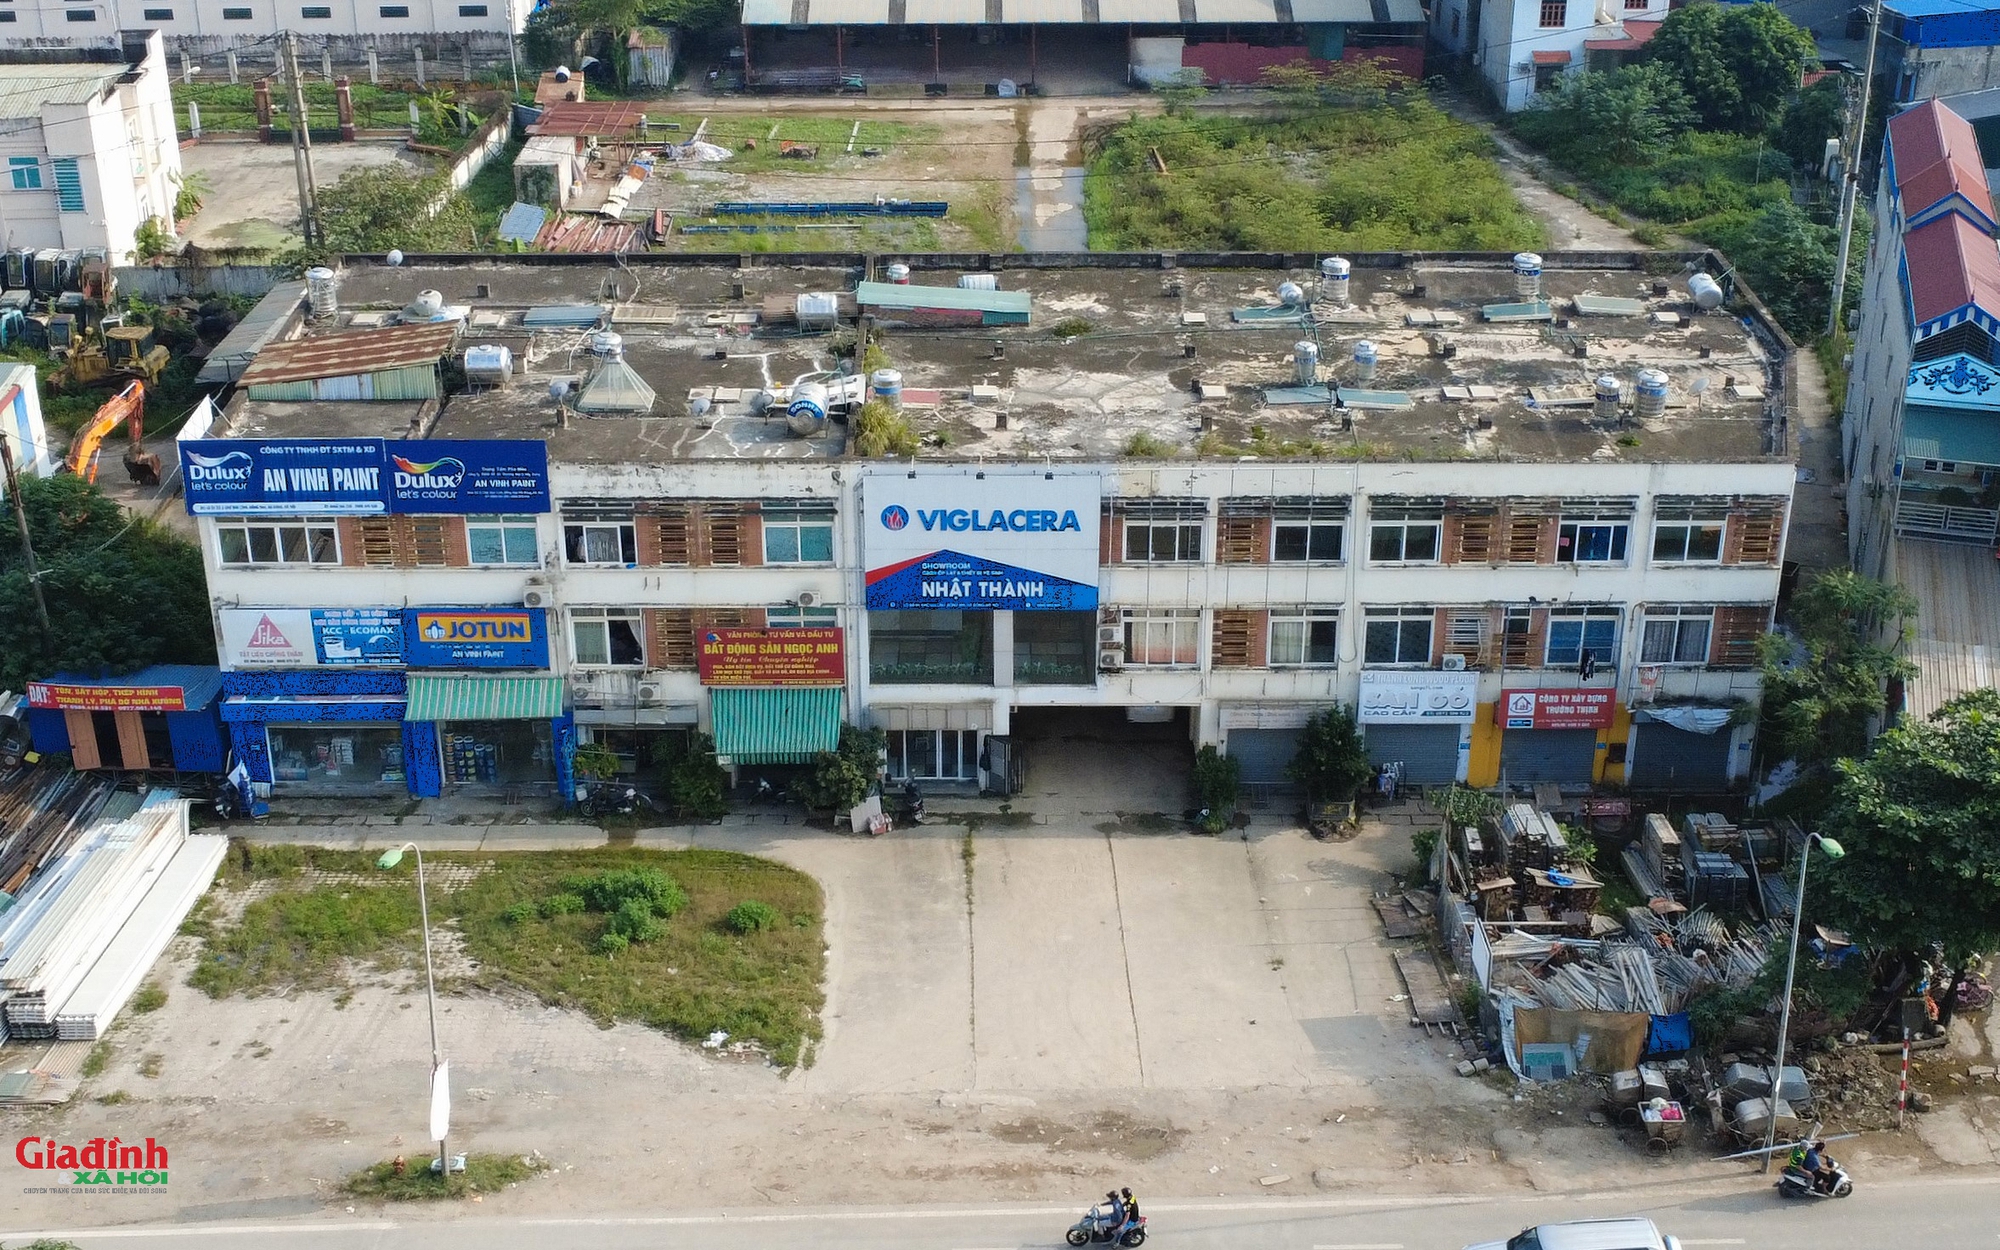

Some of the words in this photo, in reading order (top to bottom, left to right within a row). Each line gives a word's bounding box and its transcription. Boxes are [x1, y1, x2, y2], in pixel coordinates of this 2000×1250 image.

[190, 465, 246, 480] Dulux
[264, 468, 286, 491] AN
[290, 468, 329, 491] VINH
[332, 468, 380, 491] PAINT
[394, 472, 456, 488] Dulux
[191, 482, 212, 490] let's
[214, 482, 248, 490] colour
[396, 490, 420, 498] let's
[422, 490, 458, 498] colour
[917, 509, 1081, 532] VIGLACERA
[922, 577, 971, 600] NHẬT
[978, 578, 1043, 597] THÀNH
[253, 625, 285, 644] Sika
[449, 621, 525, 638] JOTUN
[704, 642, 725, 654] BẤT
[727, 643, 756, 656] ĐỘNG
[759, 641, 781, 654] SẢN
[784, 644, 813, 655] NGỌC
[816, 644, 838, 653] ANH
[1539, 694, 1559, 703] CÔNG
[1561, 694, 1570, 703] TY
[1571, 694, 1586, 703] XÂY
[1587, 694, 1608, 703] DỰNG
[1546, 704, 1575, 713] TRƯỜNG
[1577, 706, 1599, 715] THỊNH
